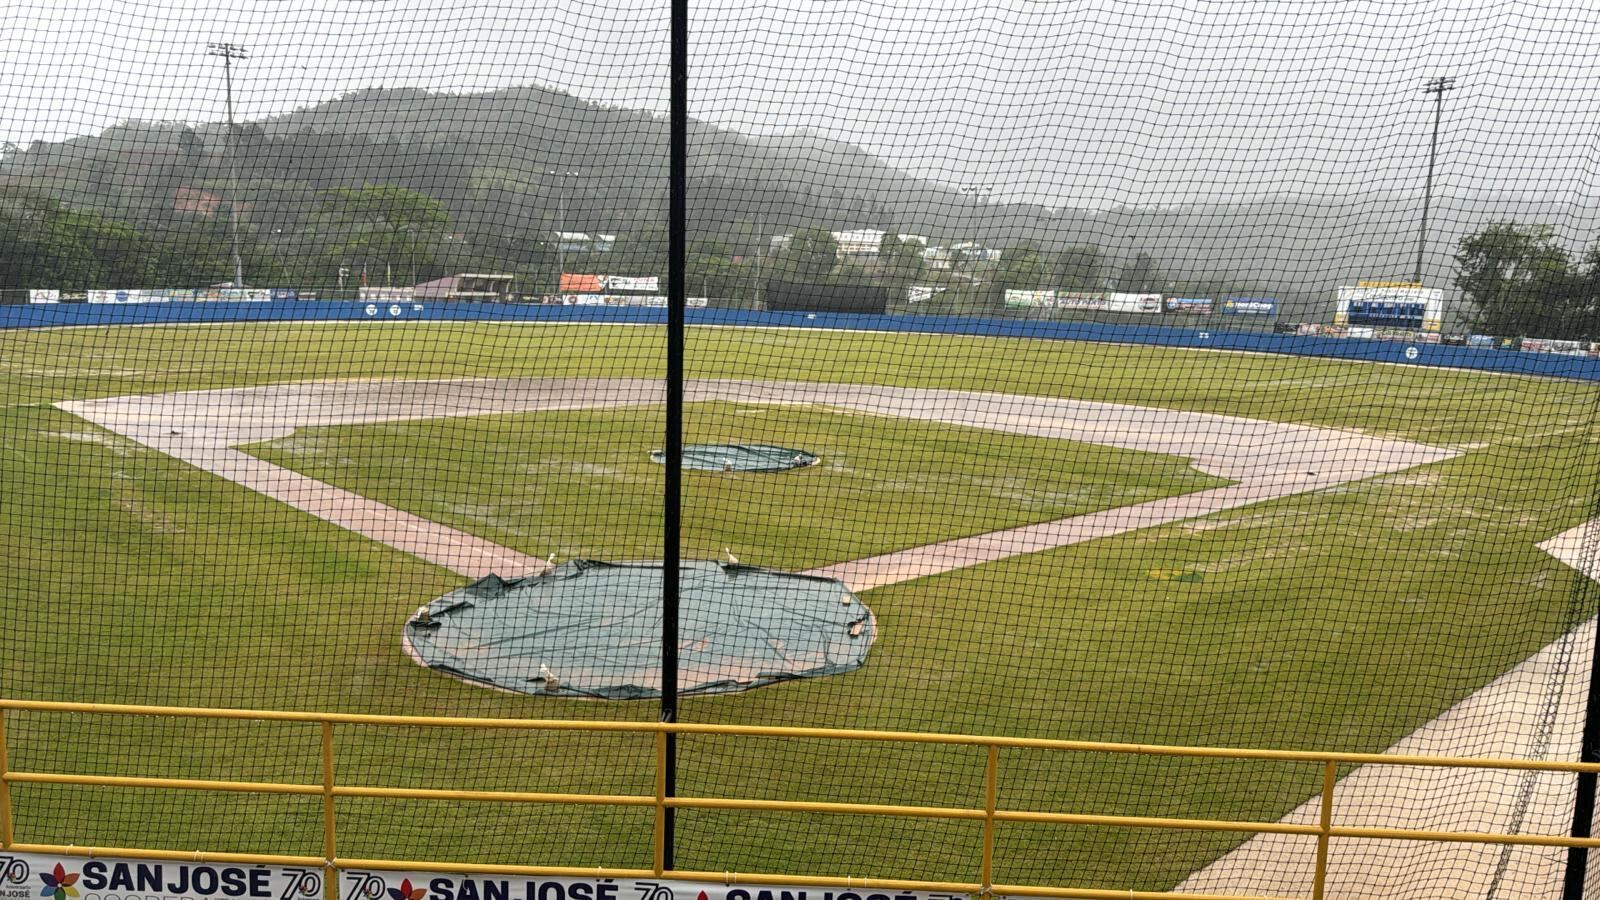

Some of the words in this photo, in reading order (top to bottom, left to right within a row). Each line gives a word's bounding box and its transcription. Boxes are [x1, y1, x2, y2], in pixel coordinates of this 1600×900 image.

[0, 856, 30, 885] 70
[83, 861, 164, 892] SAN
[168, 866, 271, 897] JOSÉ
[280, 868, 321, 900] 70
[346, 872, 386, 900] 70
[429, 878, 506, 900] SAN
[514, 879, 618, 900] JOSÉ
